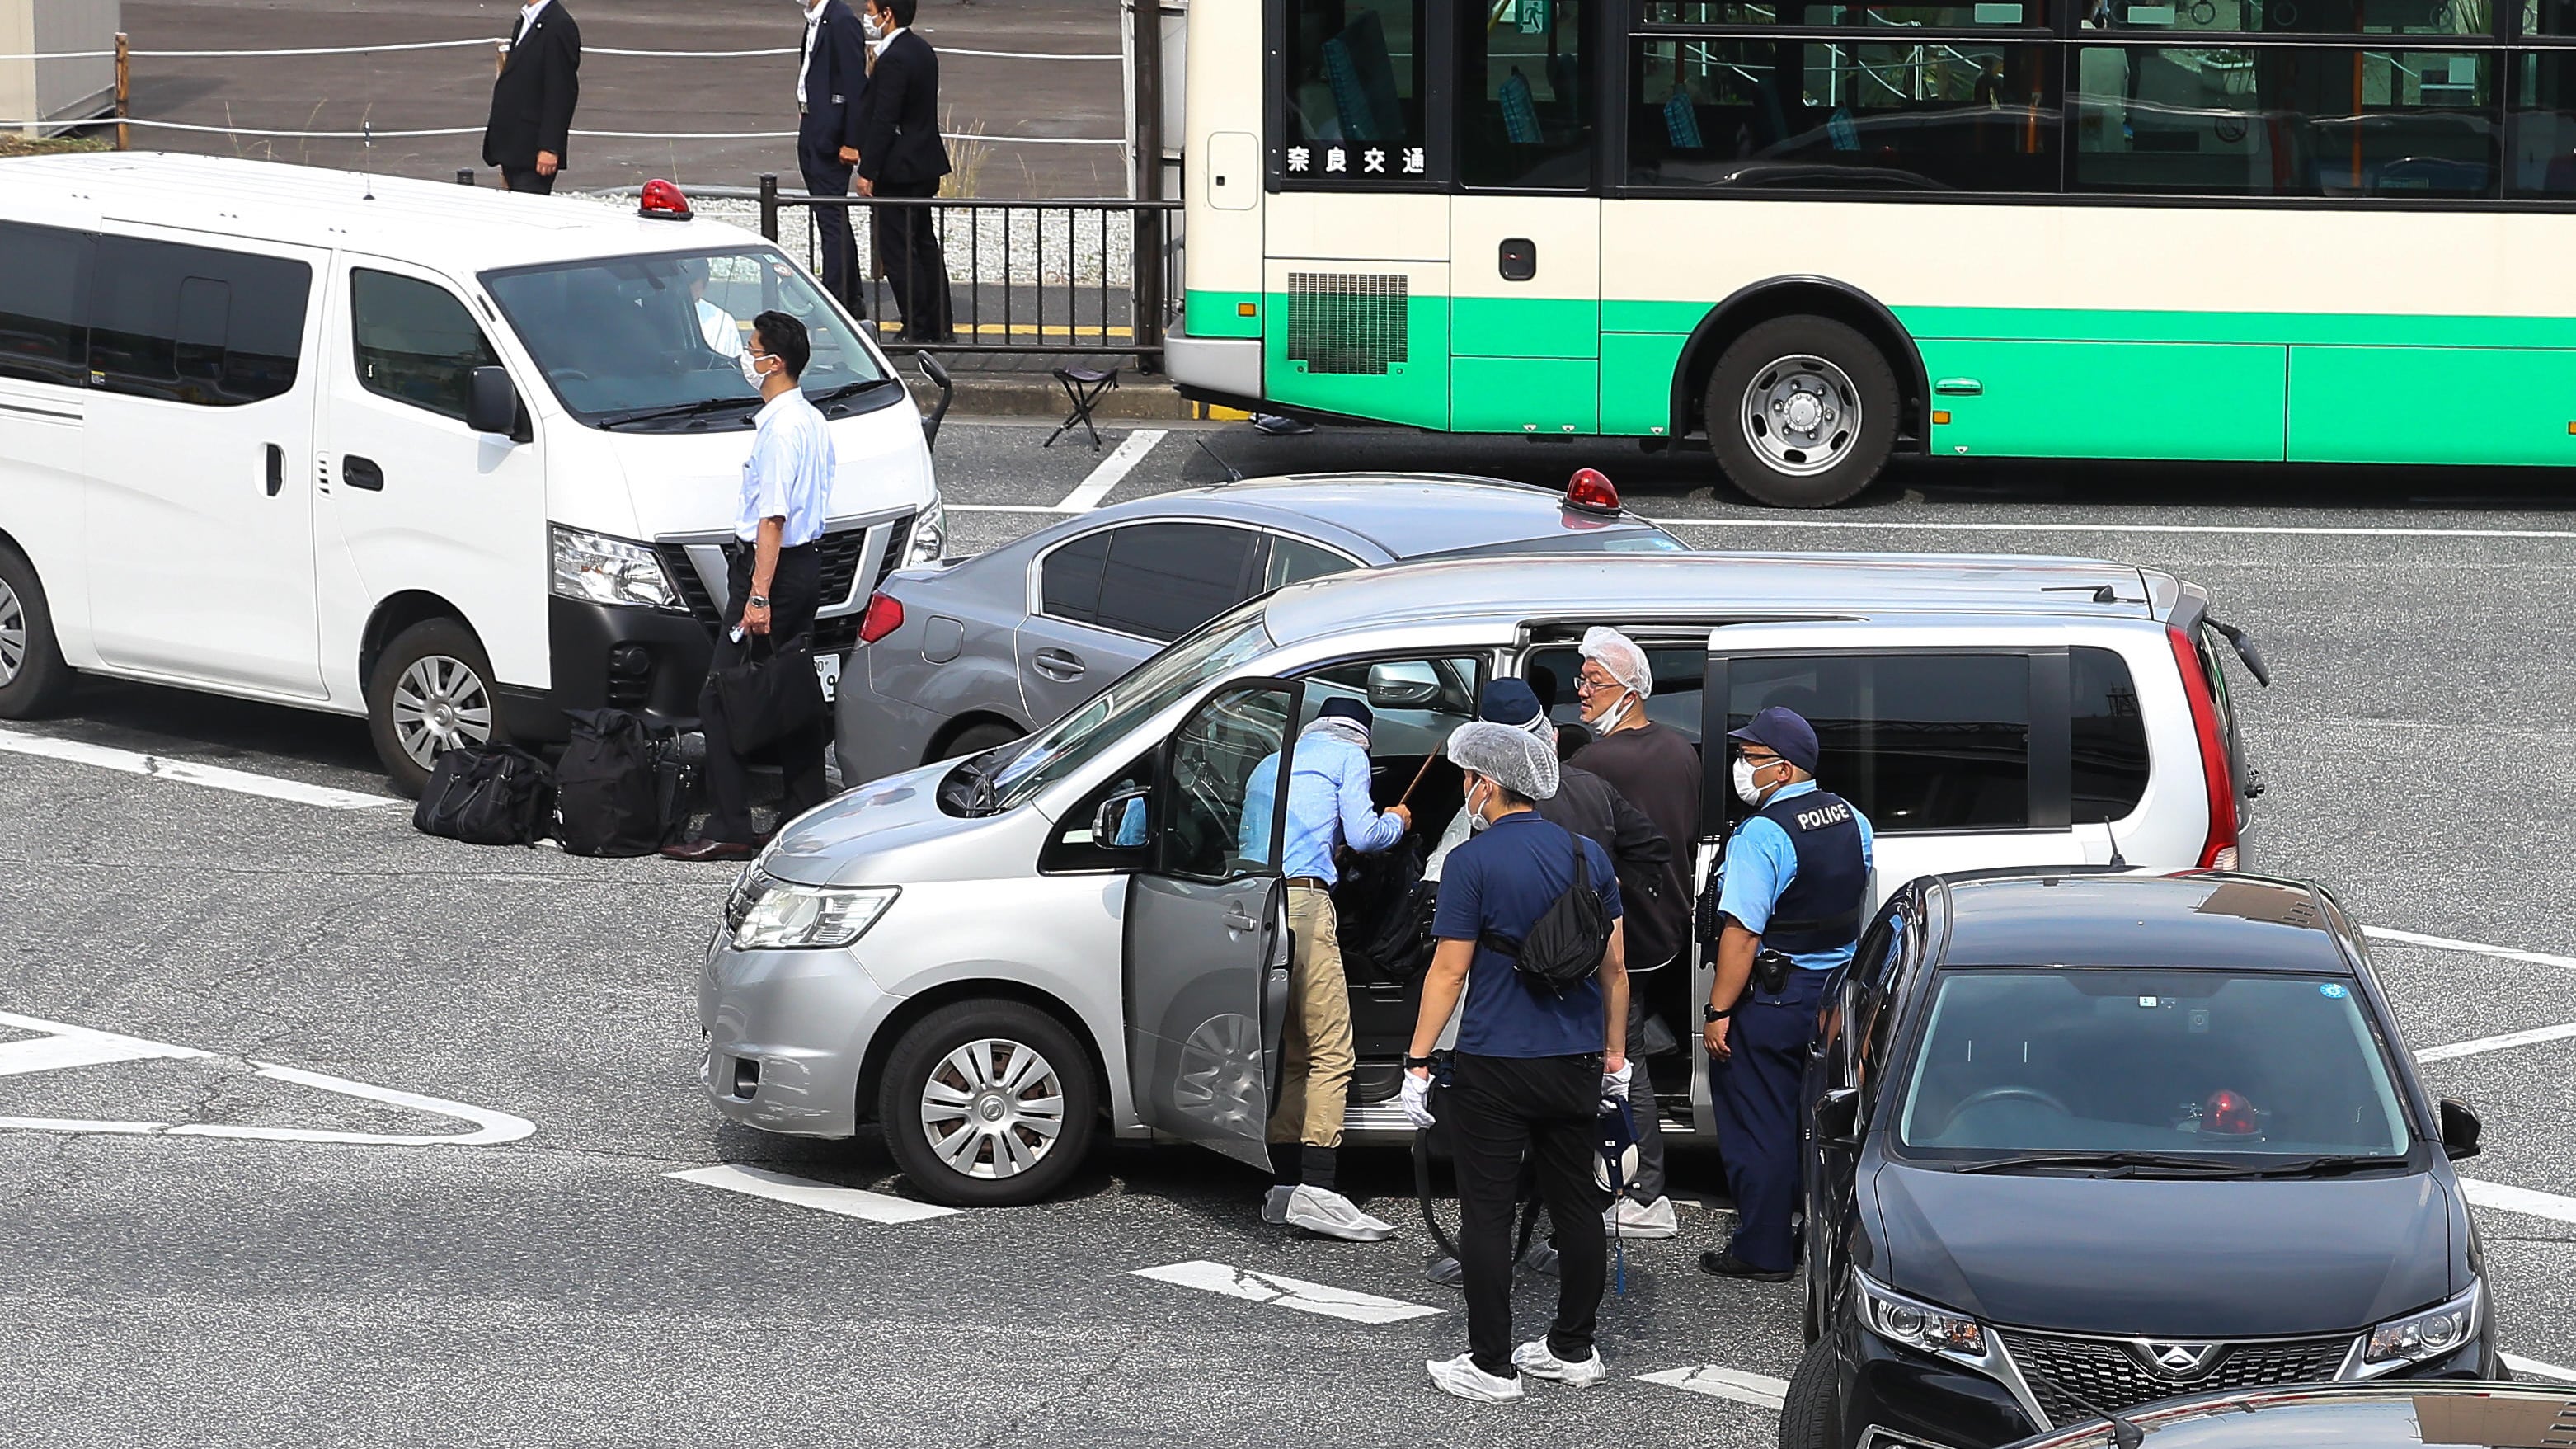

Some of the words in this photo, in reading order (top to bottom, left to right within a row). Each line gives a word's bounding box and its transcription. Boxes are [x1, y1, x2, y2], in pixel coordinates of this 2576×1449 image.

[1287, 145, 1425, 173] 奈良交通
[1798, 804, 1850, 830] POLICE
